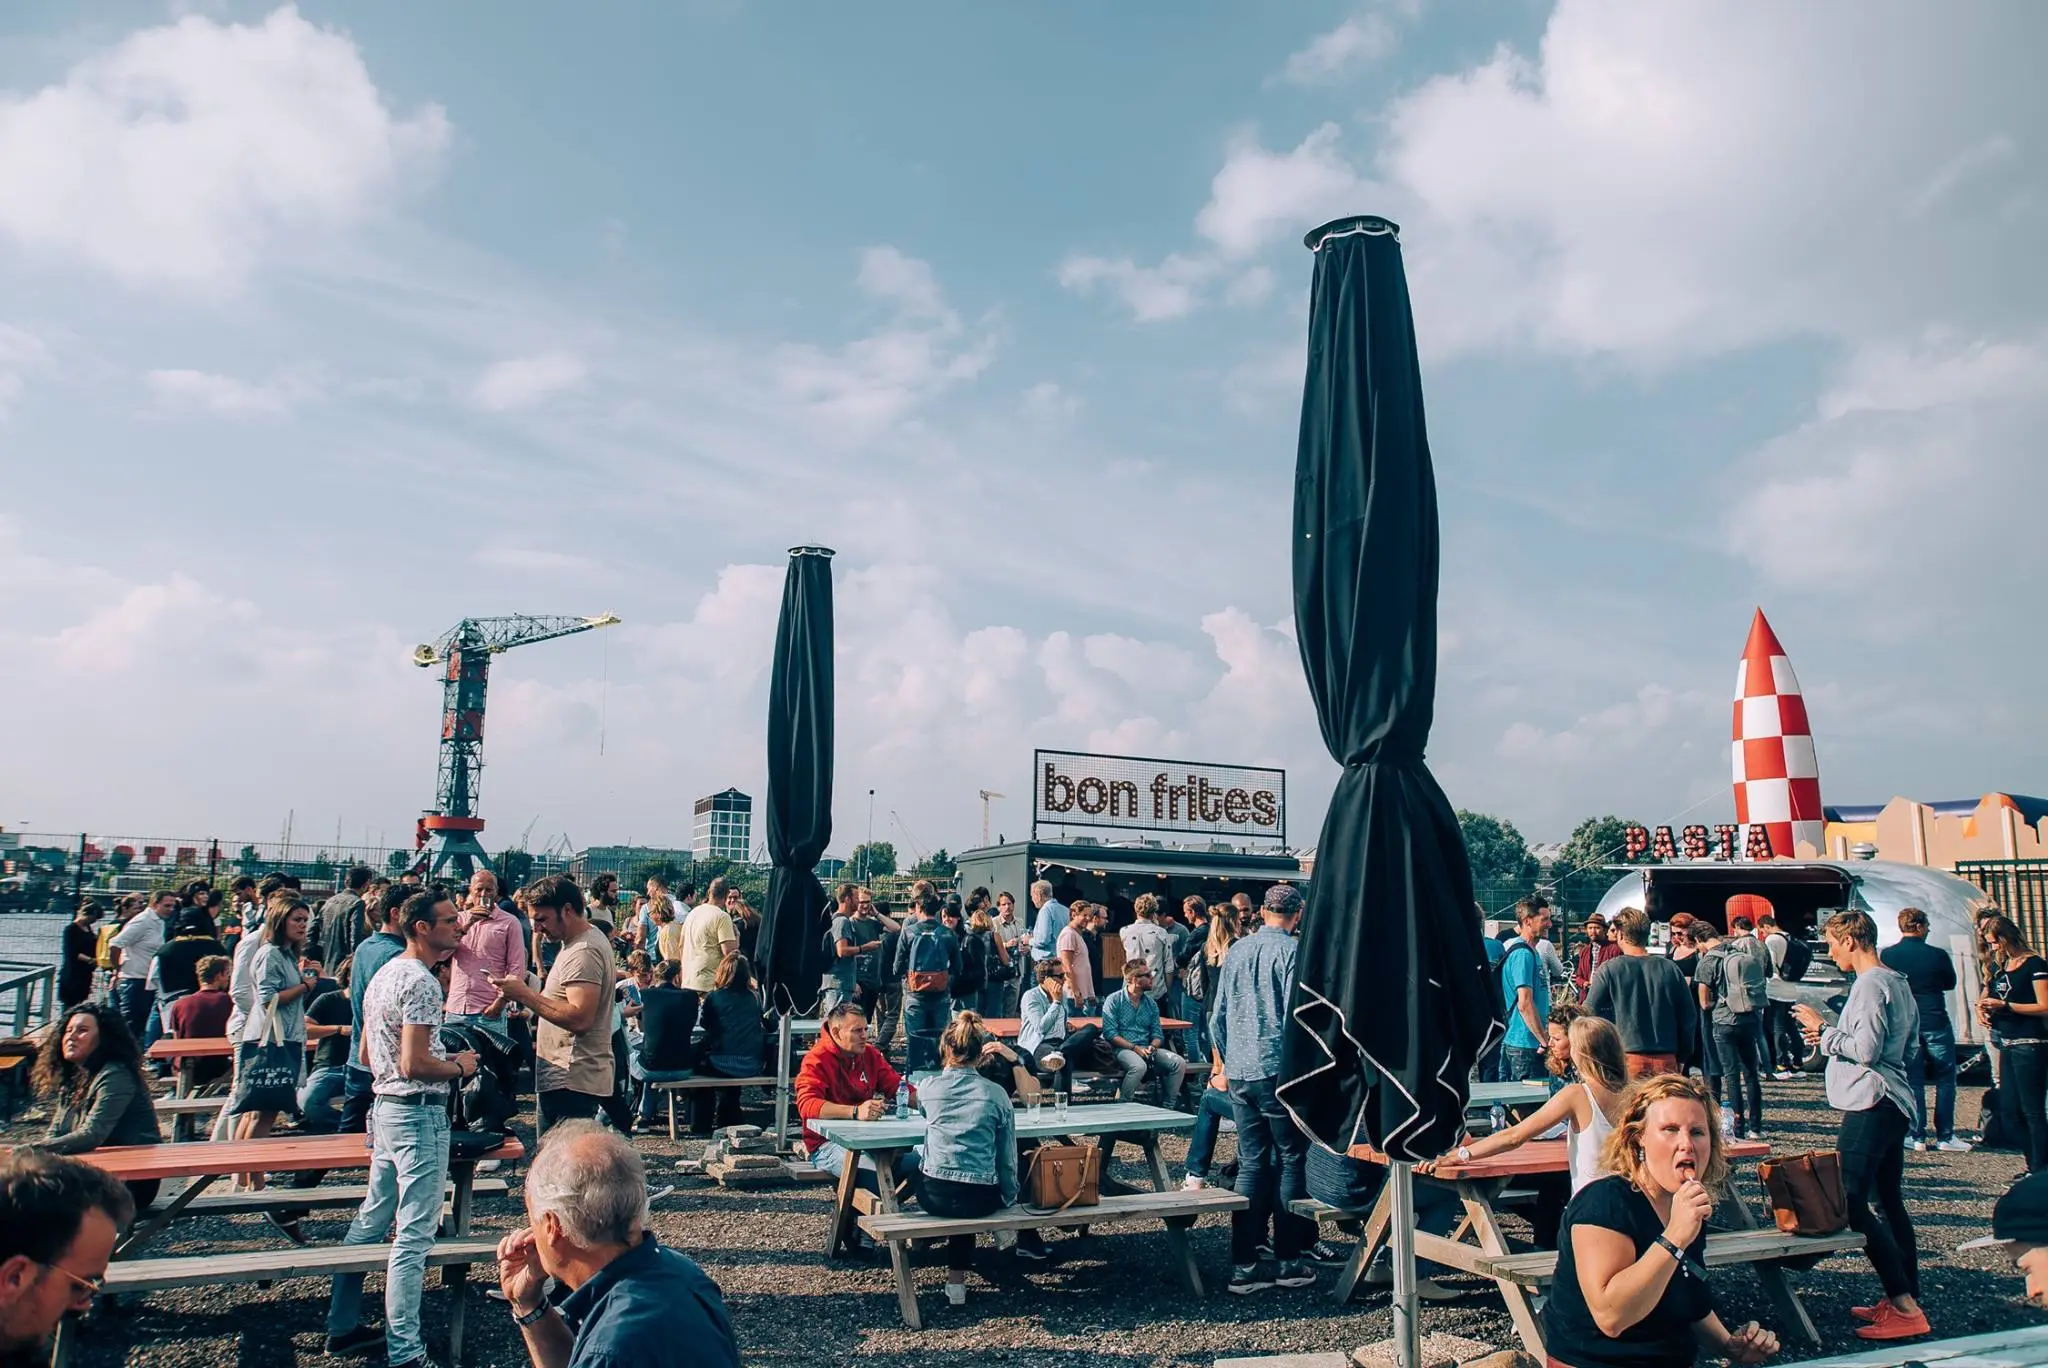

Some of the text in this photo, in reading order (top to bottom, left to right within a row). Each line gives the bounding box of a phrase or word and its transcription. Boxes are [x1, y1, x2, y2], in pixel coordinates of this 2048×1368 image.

[1044, 762, 1277, 826] bon frites
[1625, 824, 1774, 860] PASTA
[247, 1077, 294, 1086] MARKET
[251, 1066, 292, 1075] CHELSEA
